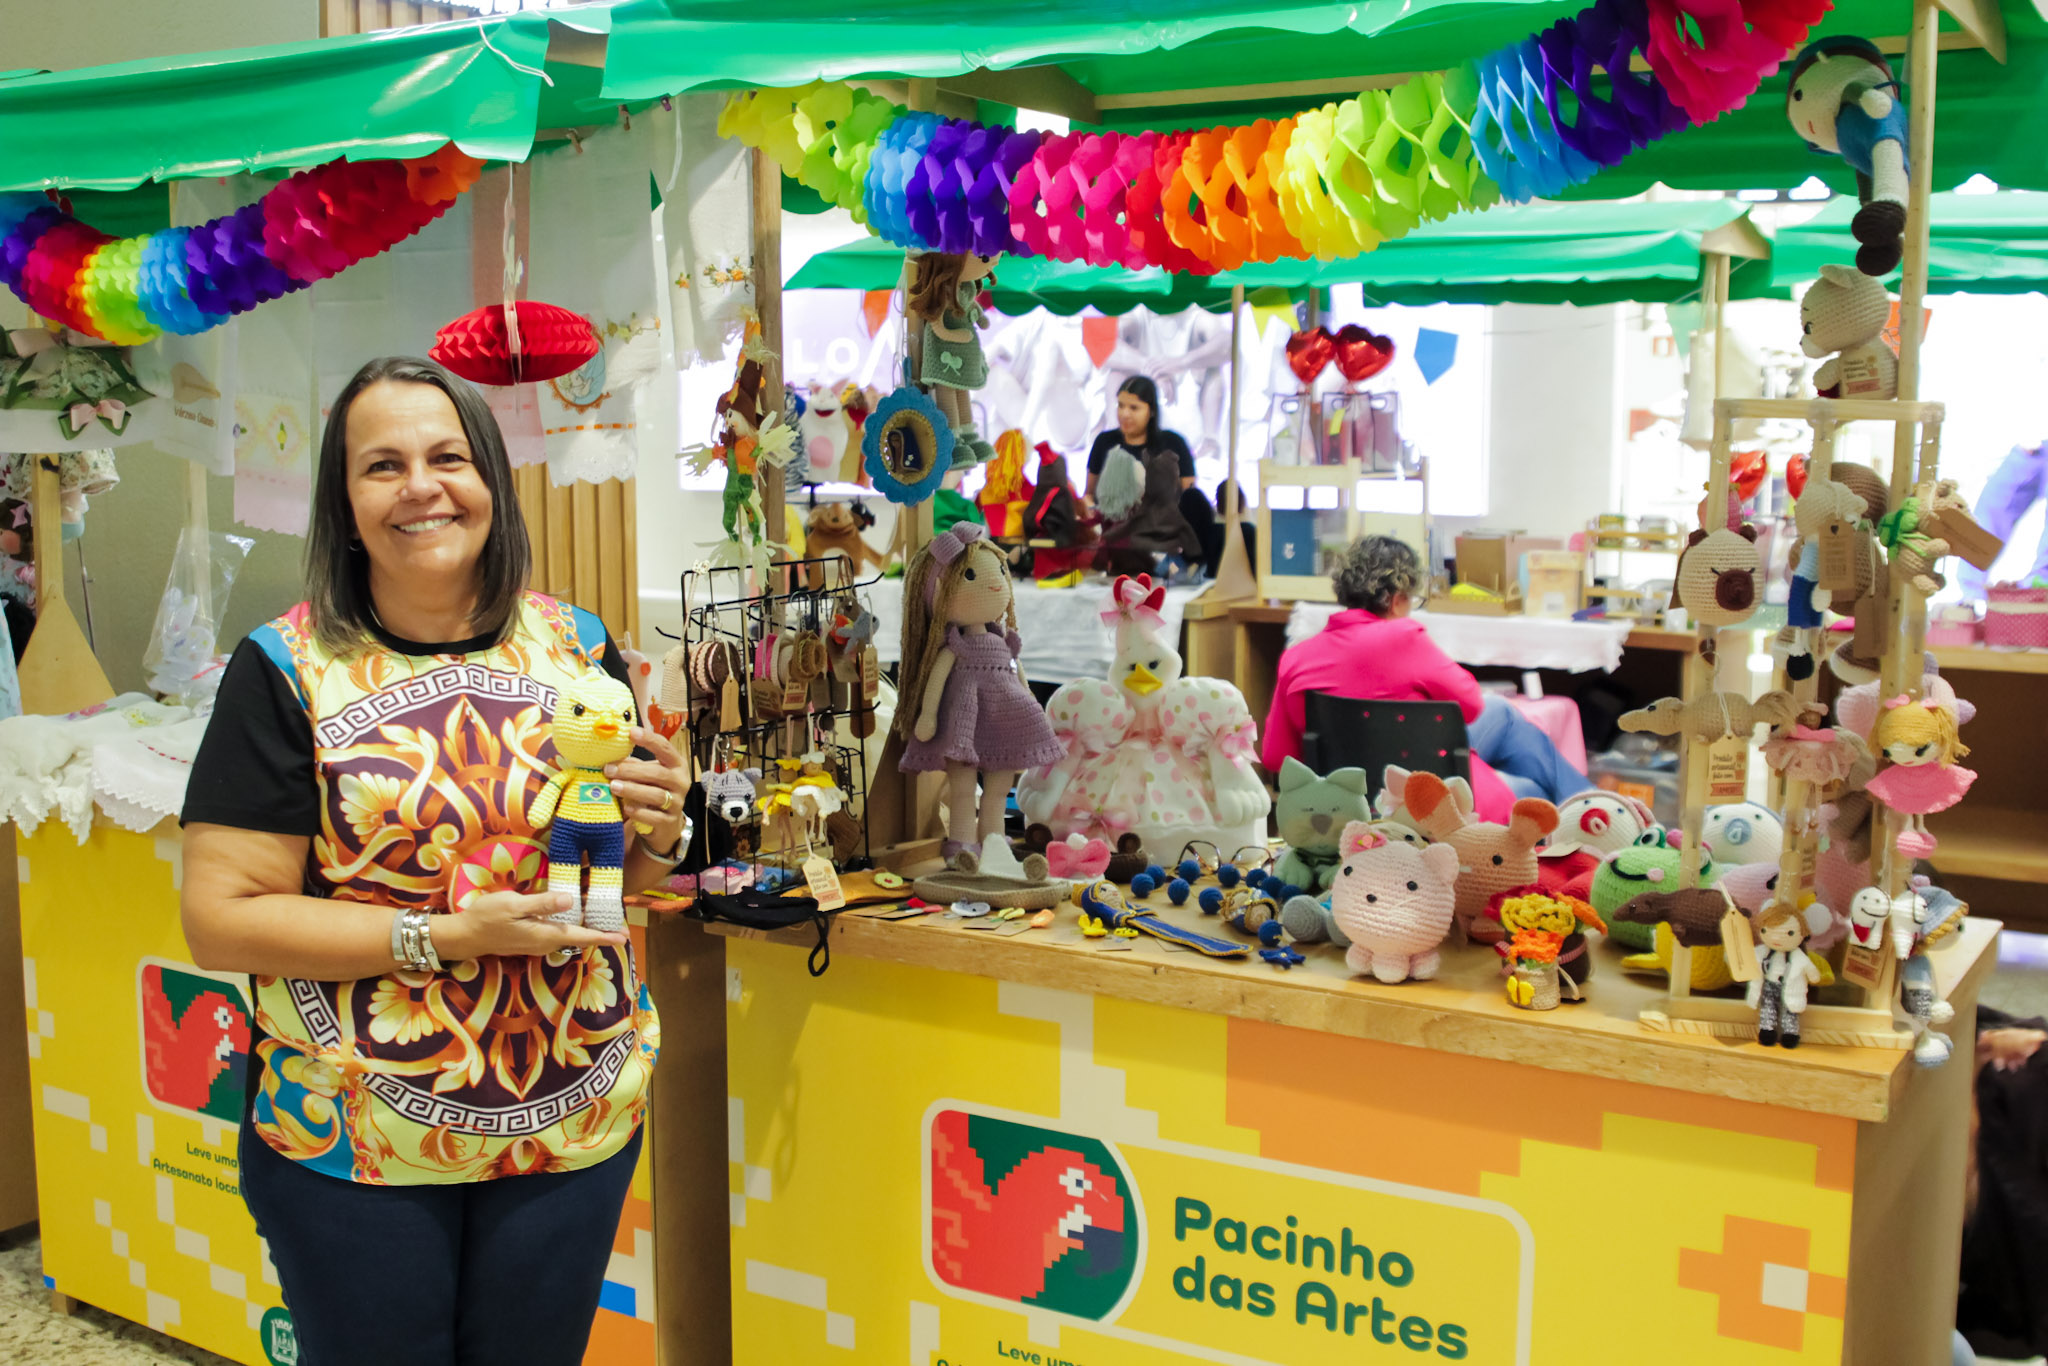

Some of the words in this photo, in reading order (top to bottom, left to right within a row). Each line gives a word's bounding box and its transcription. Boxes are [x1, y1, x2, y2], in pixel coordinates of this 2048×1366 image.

[186, 1142, 212, 1161] Leve
[214, 1153, 238, 1169] uma
[153, 1158, 213, 1188] Artesanato
[1174, 1196, 1415, 1289] Pacinho
[1172, 1254, 1277, 1318] das
[1295, 1280, 1469, 1360] Artes
[997, 1340, 1042, 1365] Leve
[1047, 1356, 1083, 1366] um
